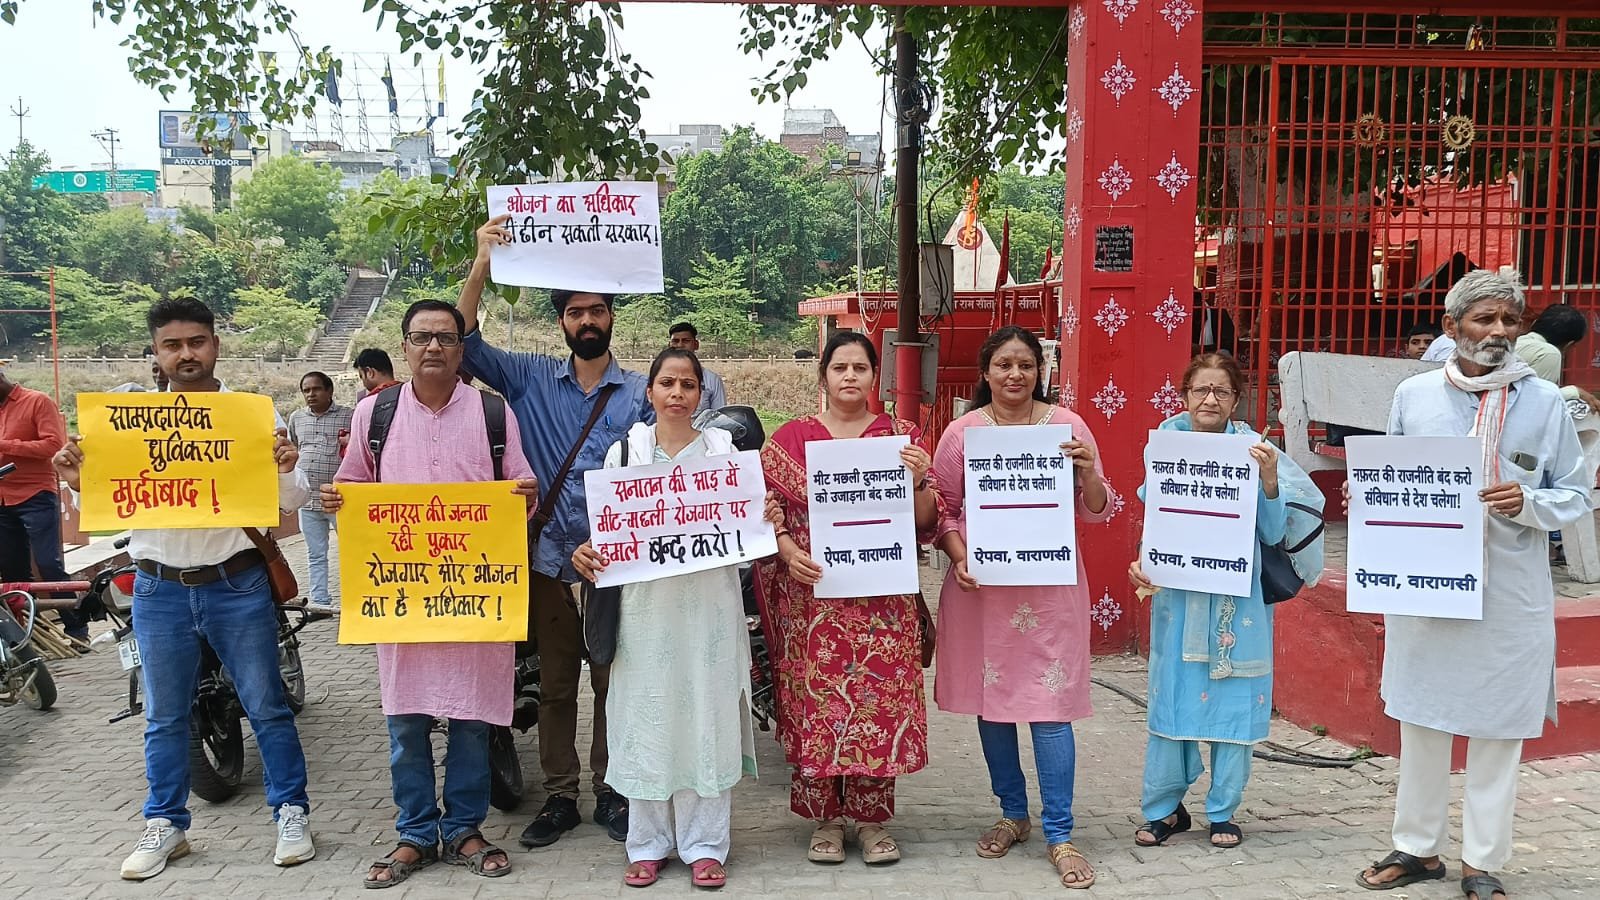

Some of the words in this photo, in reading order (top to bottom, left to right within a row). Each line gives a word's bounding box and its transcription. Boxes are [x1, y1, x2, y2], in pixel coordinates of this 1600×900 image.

[507, 188, 552, 213] भोजन
[557, 195, 576, 213] का
[582, 182, 641, 216] अधिकार
[559, 215, 603, 245] सकती
[106, 394, 213, 432] साम्प्रदायिक
[969, 458, 990, 471] नफ़रत
[993, 454, 1003, 470] की
[1005, 453, 1035, 470] राजनीति
[1036, 454, 1047, 470] बंद
[1050, 452, 1064, 469] करो
[1152, 460, 1175, 474] नफ़रत
[1177, 459, 1187, 475] की
[1189, 461, 1220, 478] राजनीति
[1222, 463, 1233, 480] बंद
[1235, 464, 1251, 480] करो
[611, 476, 665, 502] सनातन
[668, 464, 687, 494] की
[692, 468, 723, 493] आड़
[725, 460, 740, 487] में
[813, 470, 831, 486] मीट
[833, 468, 860, 484] मछली
[862, 465, 905, 487] दुकानदारों
[978, 475, 1006, 492] संविधान
[1009, 474, 1015, 491] से
[1017, 474, 1030, 491] देश
[1032, 474, 1056, 491] चलेगा!
[1353, 468, 1380, 483] नफ़रत
[1382, 465, 1395, 483] की
[1398, 465, 1435, 484] राजनीति
[1437, 467, 1451, 485] बंद
[1453, 467, 1472, 485] करो
[110, 469, 202, 519] मुर्दाबाद
[815, 488, 829, 503] को
[831, 490, 866, 505] उजाड़ना
[869, 487, 882, 500] बंद
[884, 484, 906, 499] करो!
[1160, 479, 1188, 496] संविधान
[1191, 480, 1197, 497] से
[1200, 481, 1212, 499] देश
[1214, 483, 1240, 501] चलेगा!
[1364, 487, 1399, 506] संविधान
[1401, 488, 1410, 507] से
[1413, 488, 1428, 508] देश
[1431, 489, 1461, 509] चलेगा!
[368, 504, 424, 524] बनारस
[426, 495, 446, 523] की
[448, 504, 491, 522] जनता
[672, 497, 725, 526] रोजगार
[726, 499, 751, 518] पर
[387, 524, 417, 552] रही
[425, 532, 471, 557] पुकार
[597, 532, 644, 568] हमले
[648, 533, 686, 564] बन्द
[691, 523, 731, 558] करो
[824, 547, 855, 567] ऐपवा,
[858, 542, 903, 563] वाराणसी
[974, 548, 1012, 564] ऐपवा,
[1016, 546, 1071, 562] वाराणसी
[1149, 549, 1186, 568] ऐपवा,
[1191, 557, 1248, 573] वाराणसी
[366, 553, 432, 586] रोजगार
[438, 555, 470, 585] और
[472, 553, 523, 584] भोजन
[1355, 568, 1401, 589] ऐपवा,
[1408, 574, 1477, 591] वाराणसी
[362, 595, 389, 617] का
[394, 587, 409, 616] है
[424, 585, 490, 617] अधिकार
